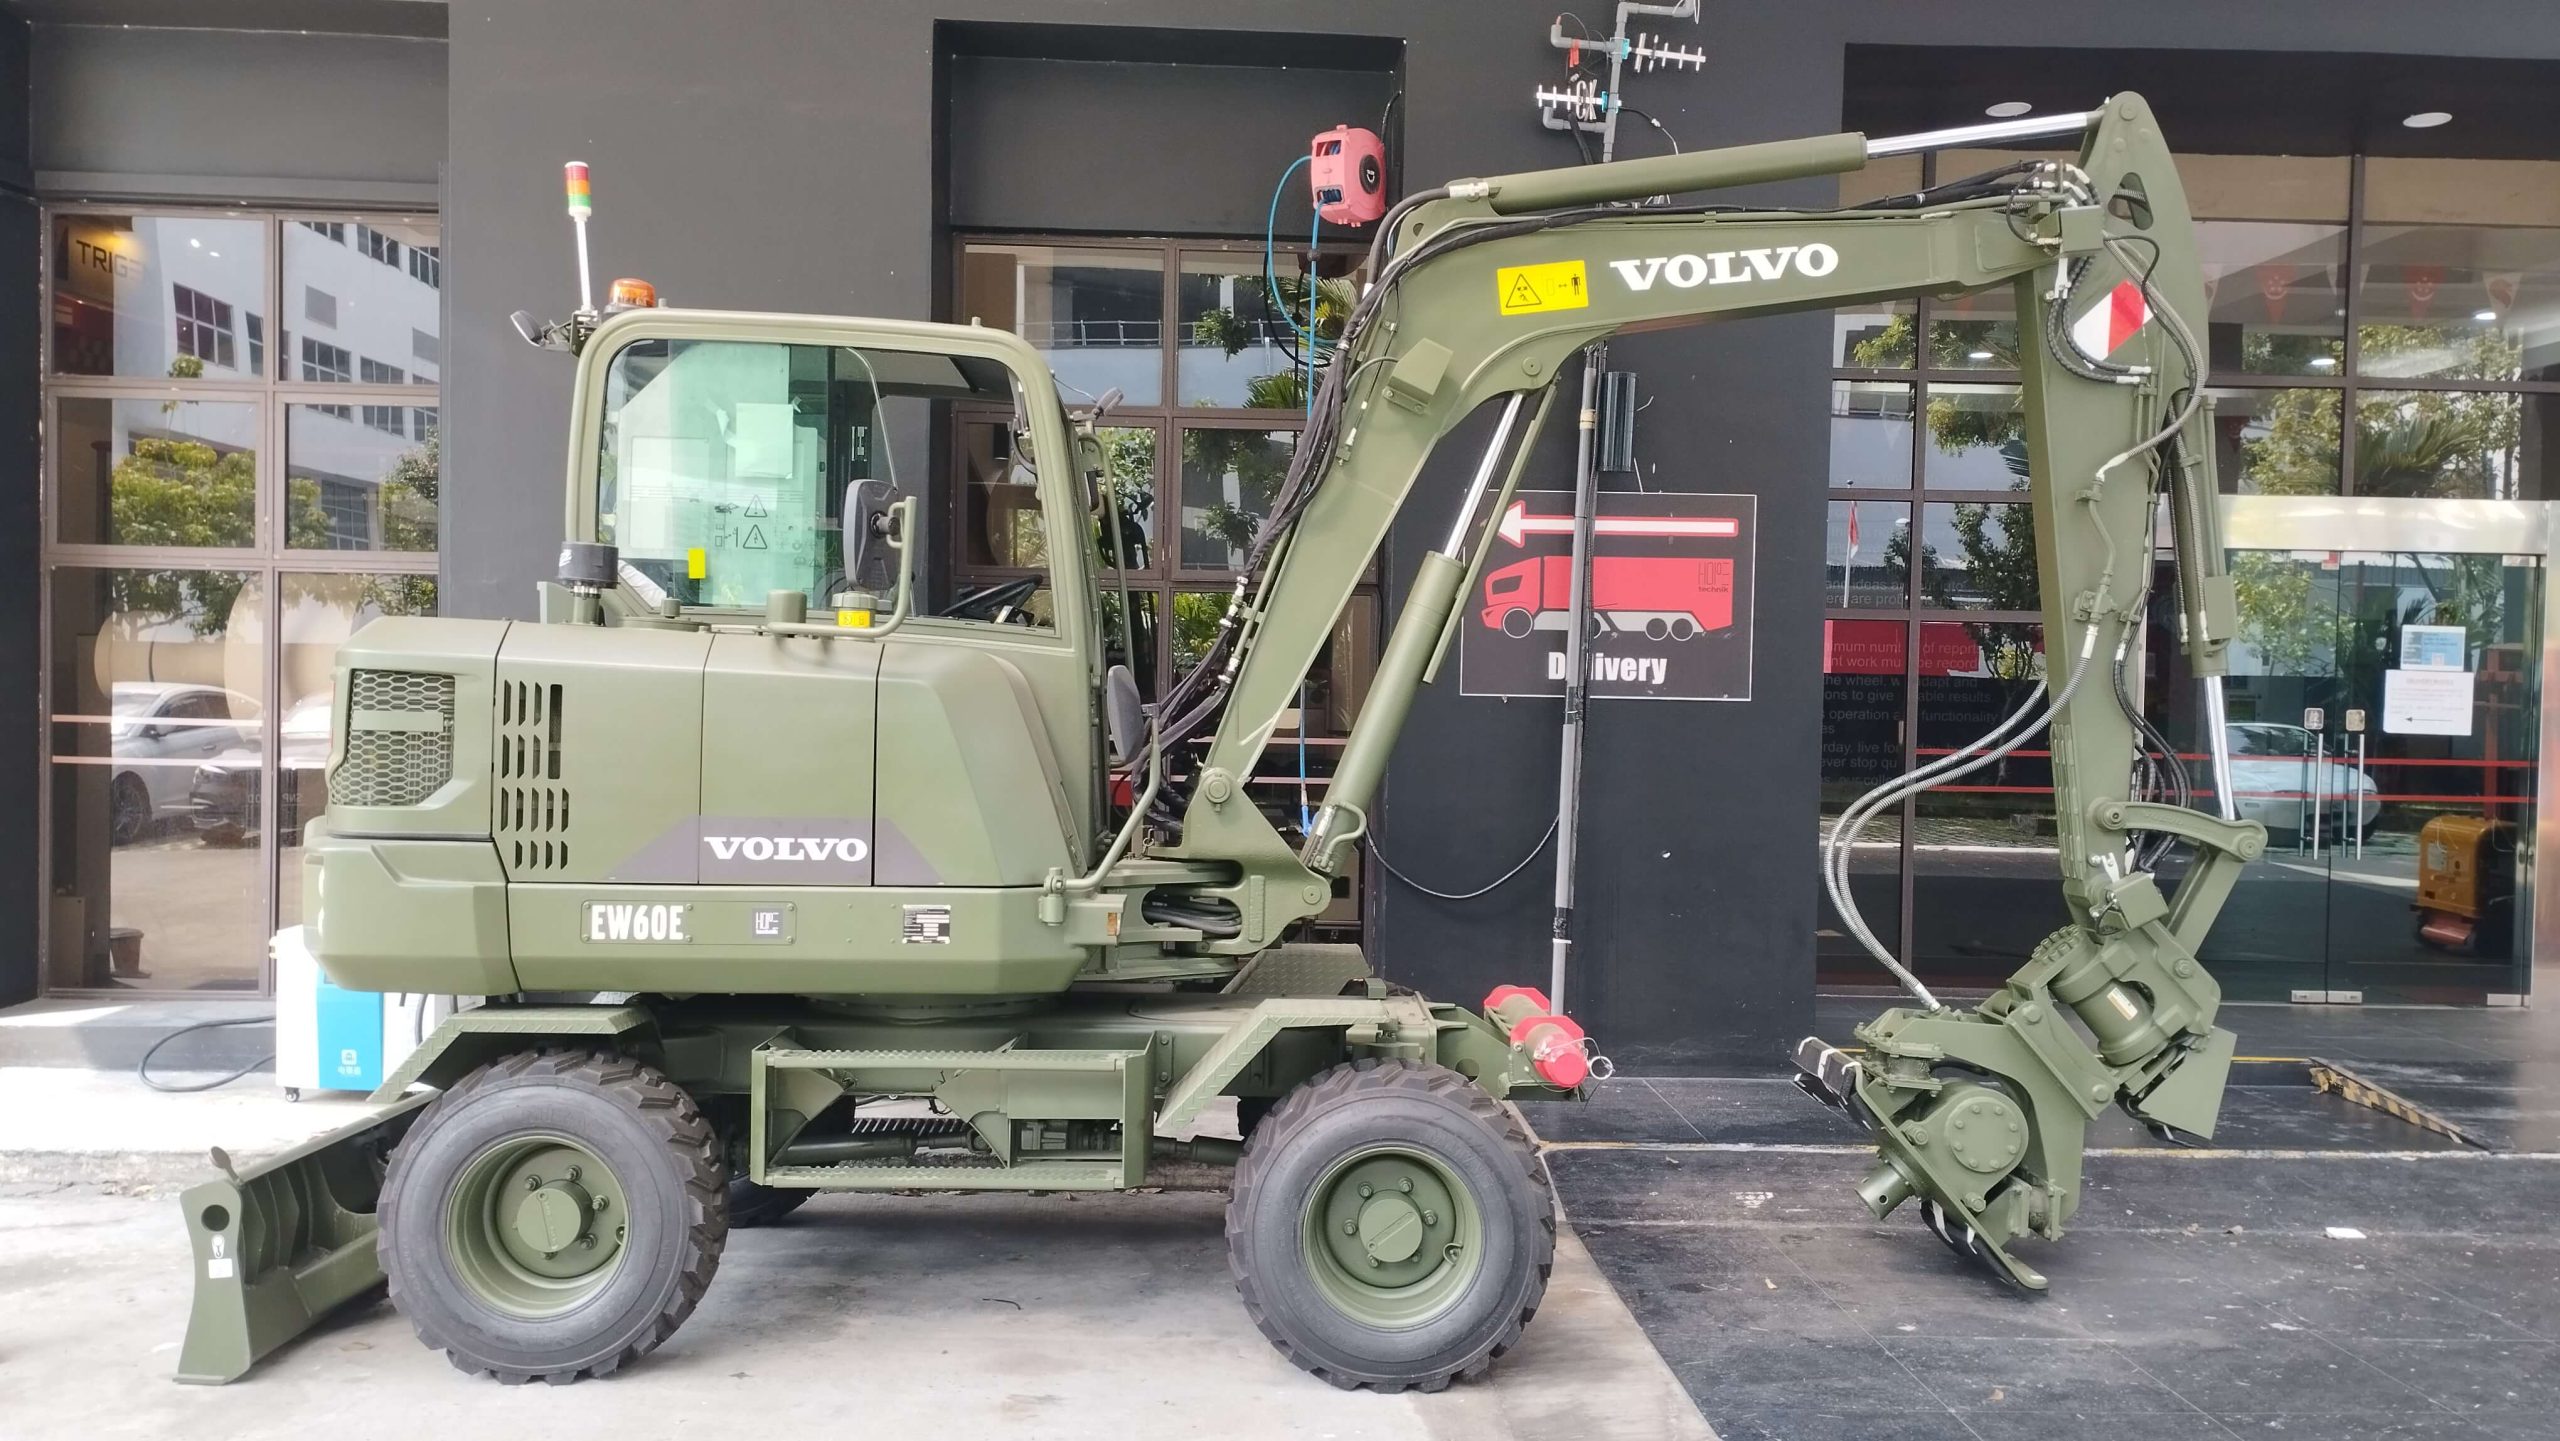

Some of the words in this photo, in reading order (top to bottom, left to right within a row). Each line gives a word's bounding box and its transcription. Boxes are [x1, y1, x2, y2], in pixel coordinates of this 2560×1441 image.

[1609, 243, 1839, 291] VOLVO
[1850, 594, 1872, 604] are
[1833, 642, 1865, 653] mum
[1548, 652, 1668, 684] Divery
[1846, 655, 1878, 667] work
[1881, 657, 1902, 668] mu
[1937, 656, 1977, 668] record
[1824, 689, 1848, 700] ons
[1851, 689, 1864, 701] to
[1866, 689, 1894, 704] give
[1918, 690, 1945, 702] able
[1829, 708, 1889, 722] operation
[1921, 709, 1999, 725] functionality
[1857, 740, 1880, 753] live
[1850, 756, 1878, 771] stop
[1881, 759, 1898, 771] qu
[704, 837, 868, 862] VOLVO
[591, 904, 685, 941] EW60E
